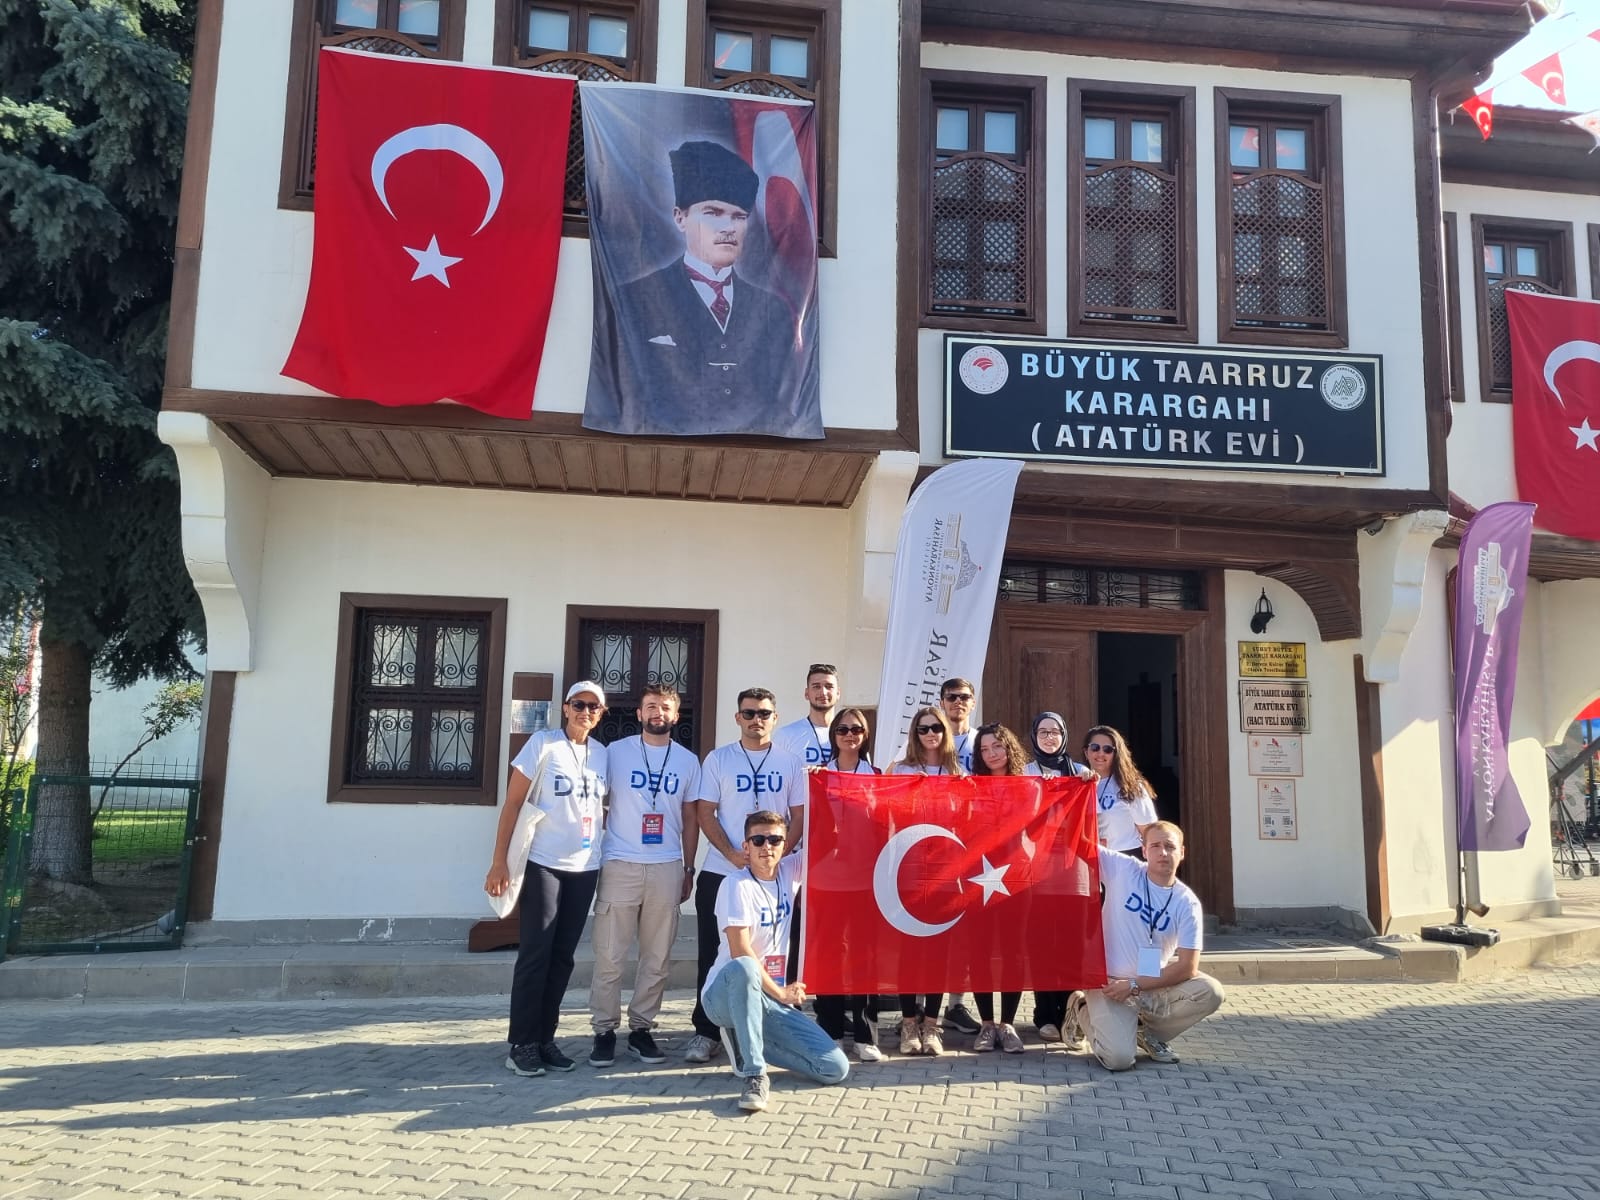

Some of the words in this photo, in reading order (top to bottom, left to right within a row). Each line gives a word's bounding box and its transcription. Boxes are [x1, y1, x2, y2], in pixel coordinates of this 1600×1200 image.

[1021, 349, 1141, 382] BÜYÜK
[1153, 359, 1314, 389] TAARRUZ
[1065, 390, 1271, 422] KARARGAHI
[1056, 421, 1213, 454] ATATÜRK
[1227, 428, 1280, 457] EVİ
[1253, 701, 1286, 711] ATATÜRK
[1286, 702, 1299, 711] EVİ
[1246, 716, 1264, 727] (HACI
[1264, 714, 1280, 726] VELİ
[806, 747, 832, 763] DE
[630, 770, 679, 795] DEÜ
[736, 771, 782, 793] DEÜ
[1124, 892, 1171, 931] DEÜ
